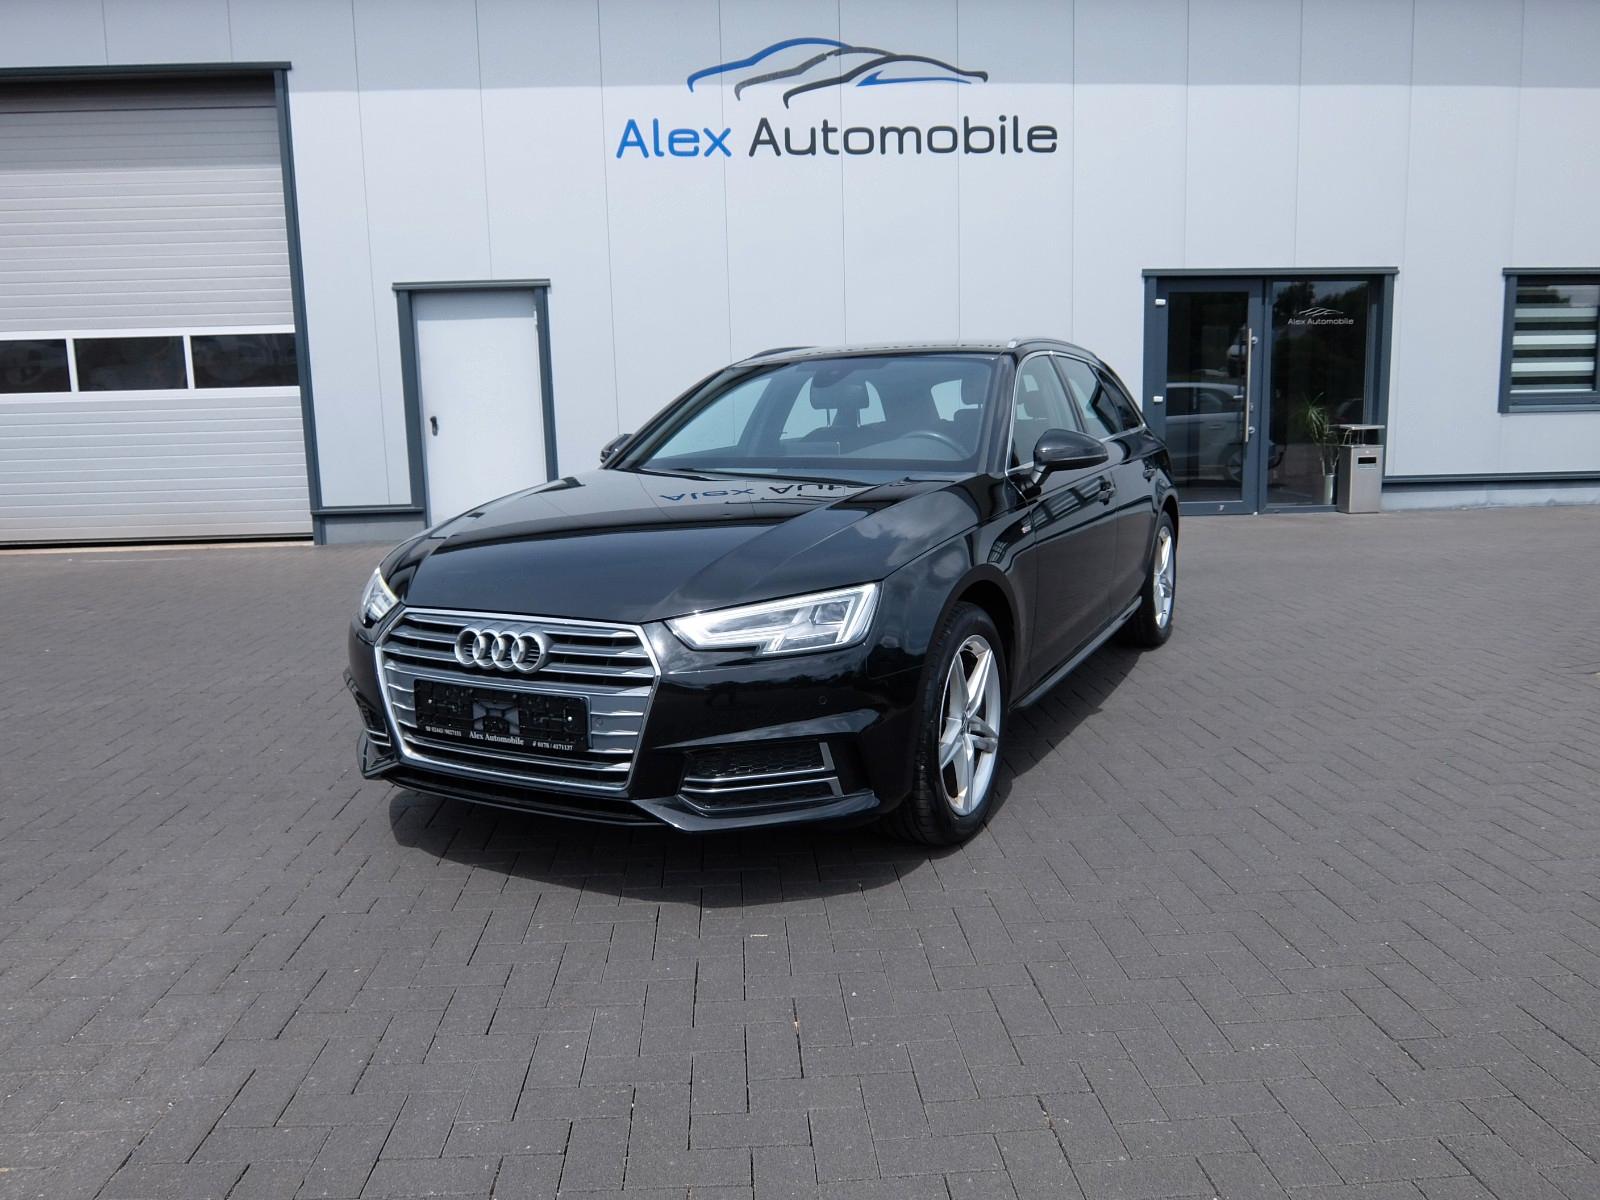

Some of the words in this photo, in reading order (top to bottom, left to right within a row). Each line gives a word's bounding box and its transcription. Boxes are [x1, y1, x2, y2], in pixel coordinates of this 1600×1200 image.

[615, 117, 732, 159] Alex
[748, 114, 1059, 157] Automobile
[469, 730, 485, 740] Alex
[485, 733, 524, 746] Automobile
